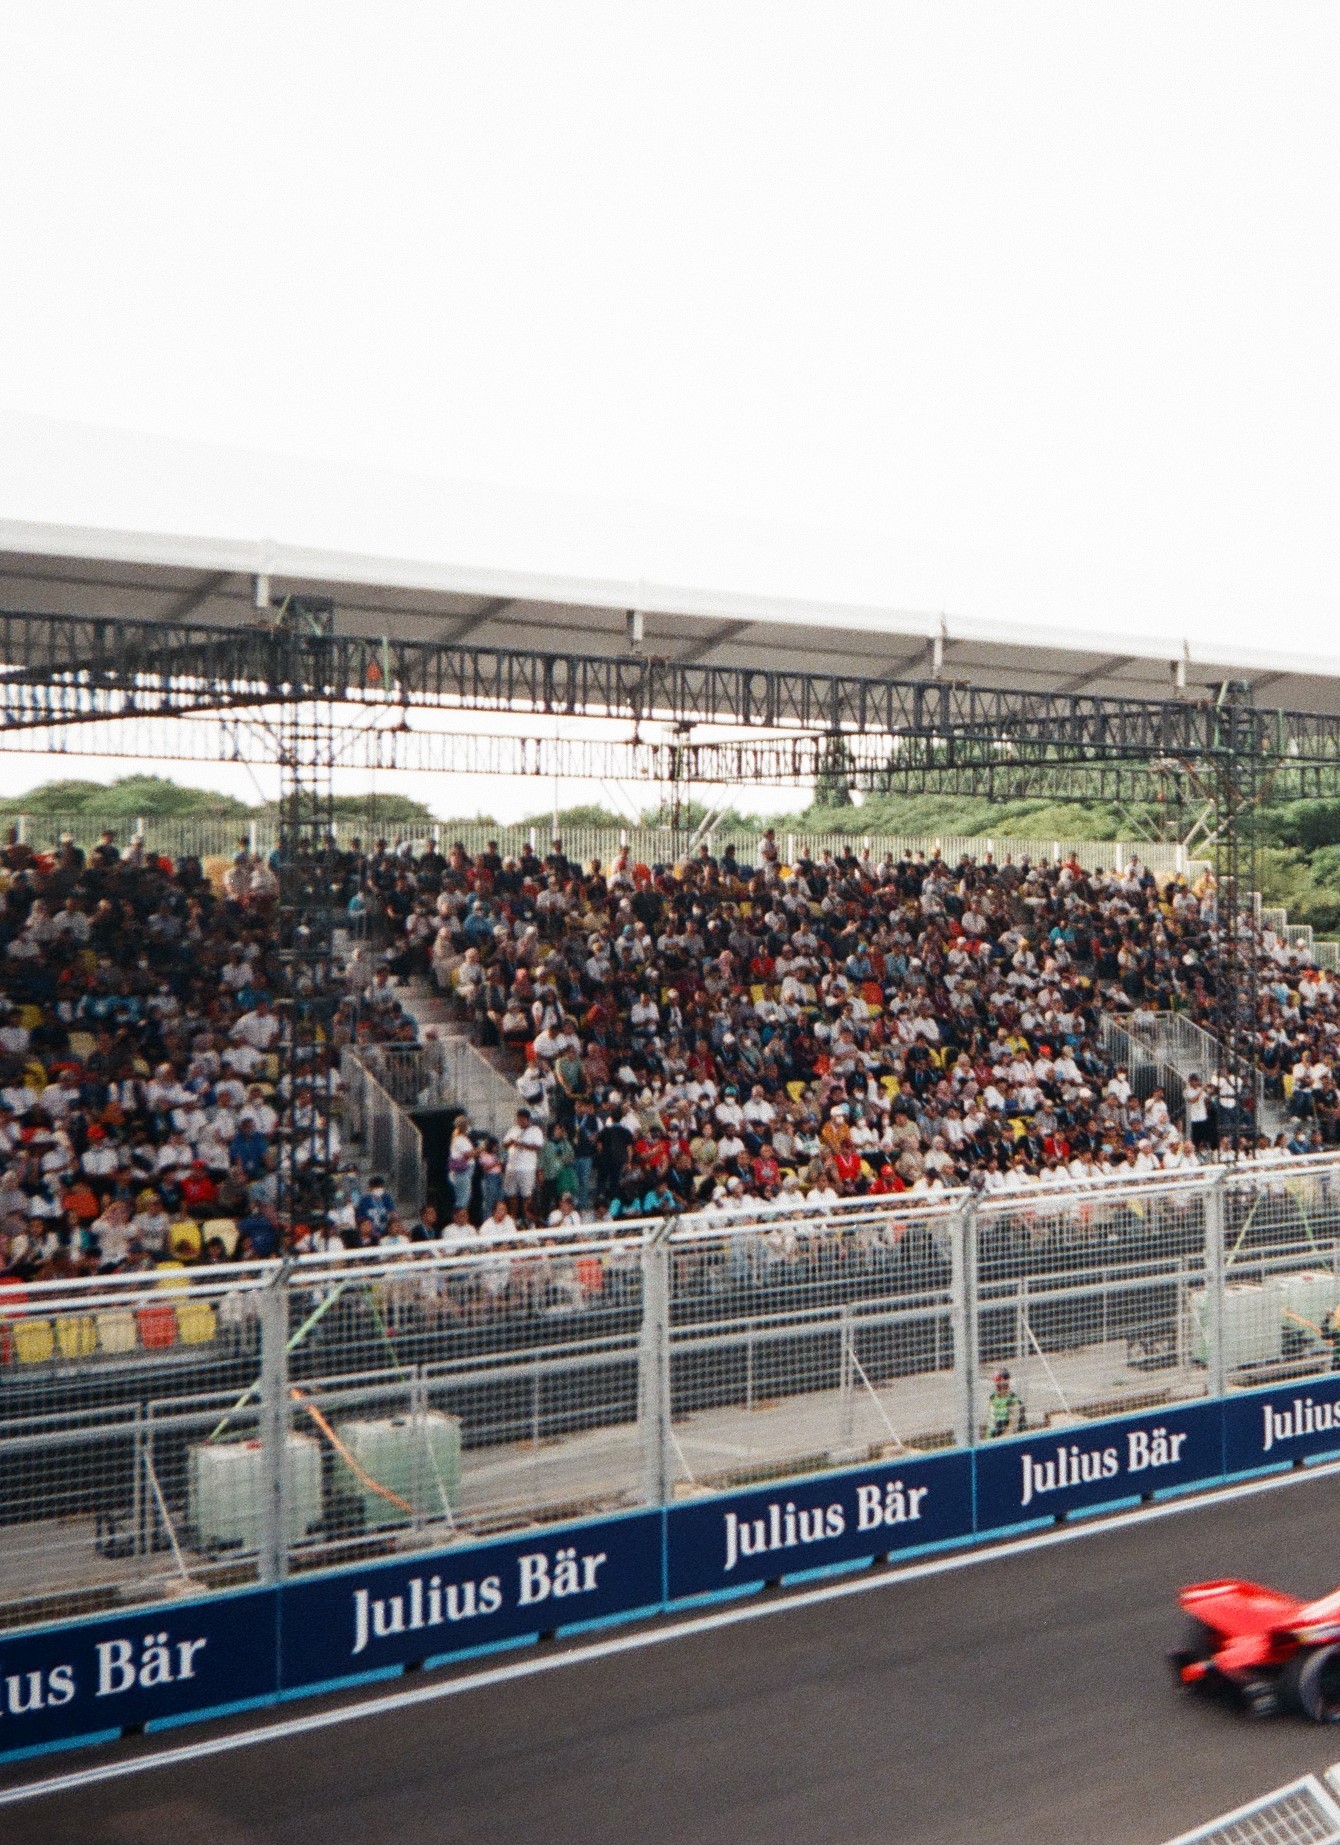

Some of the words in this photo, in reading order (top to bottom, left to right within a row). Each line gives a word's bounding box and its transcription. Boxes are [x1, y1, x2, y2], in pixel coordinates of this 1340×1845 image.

[1021, 1446, 1119, 1506] Julius
[1127, 1428, 1187, 1473] Bär
[723, 1502, 845, 1572] Julius
[856, 1480, 928, 1532] Bär
[352, 1575, 503, 1654] Julius
[517, 1547, 607, 1606] Bär
[0, 1665, 75, 1717] us
[95, 1631, 207, 1697] Bär
